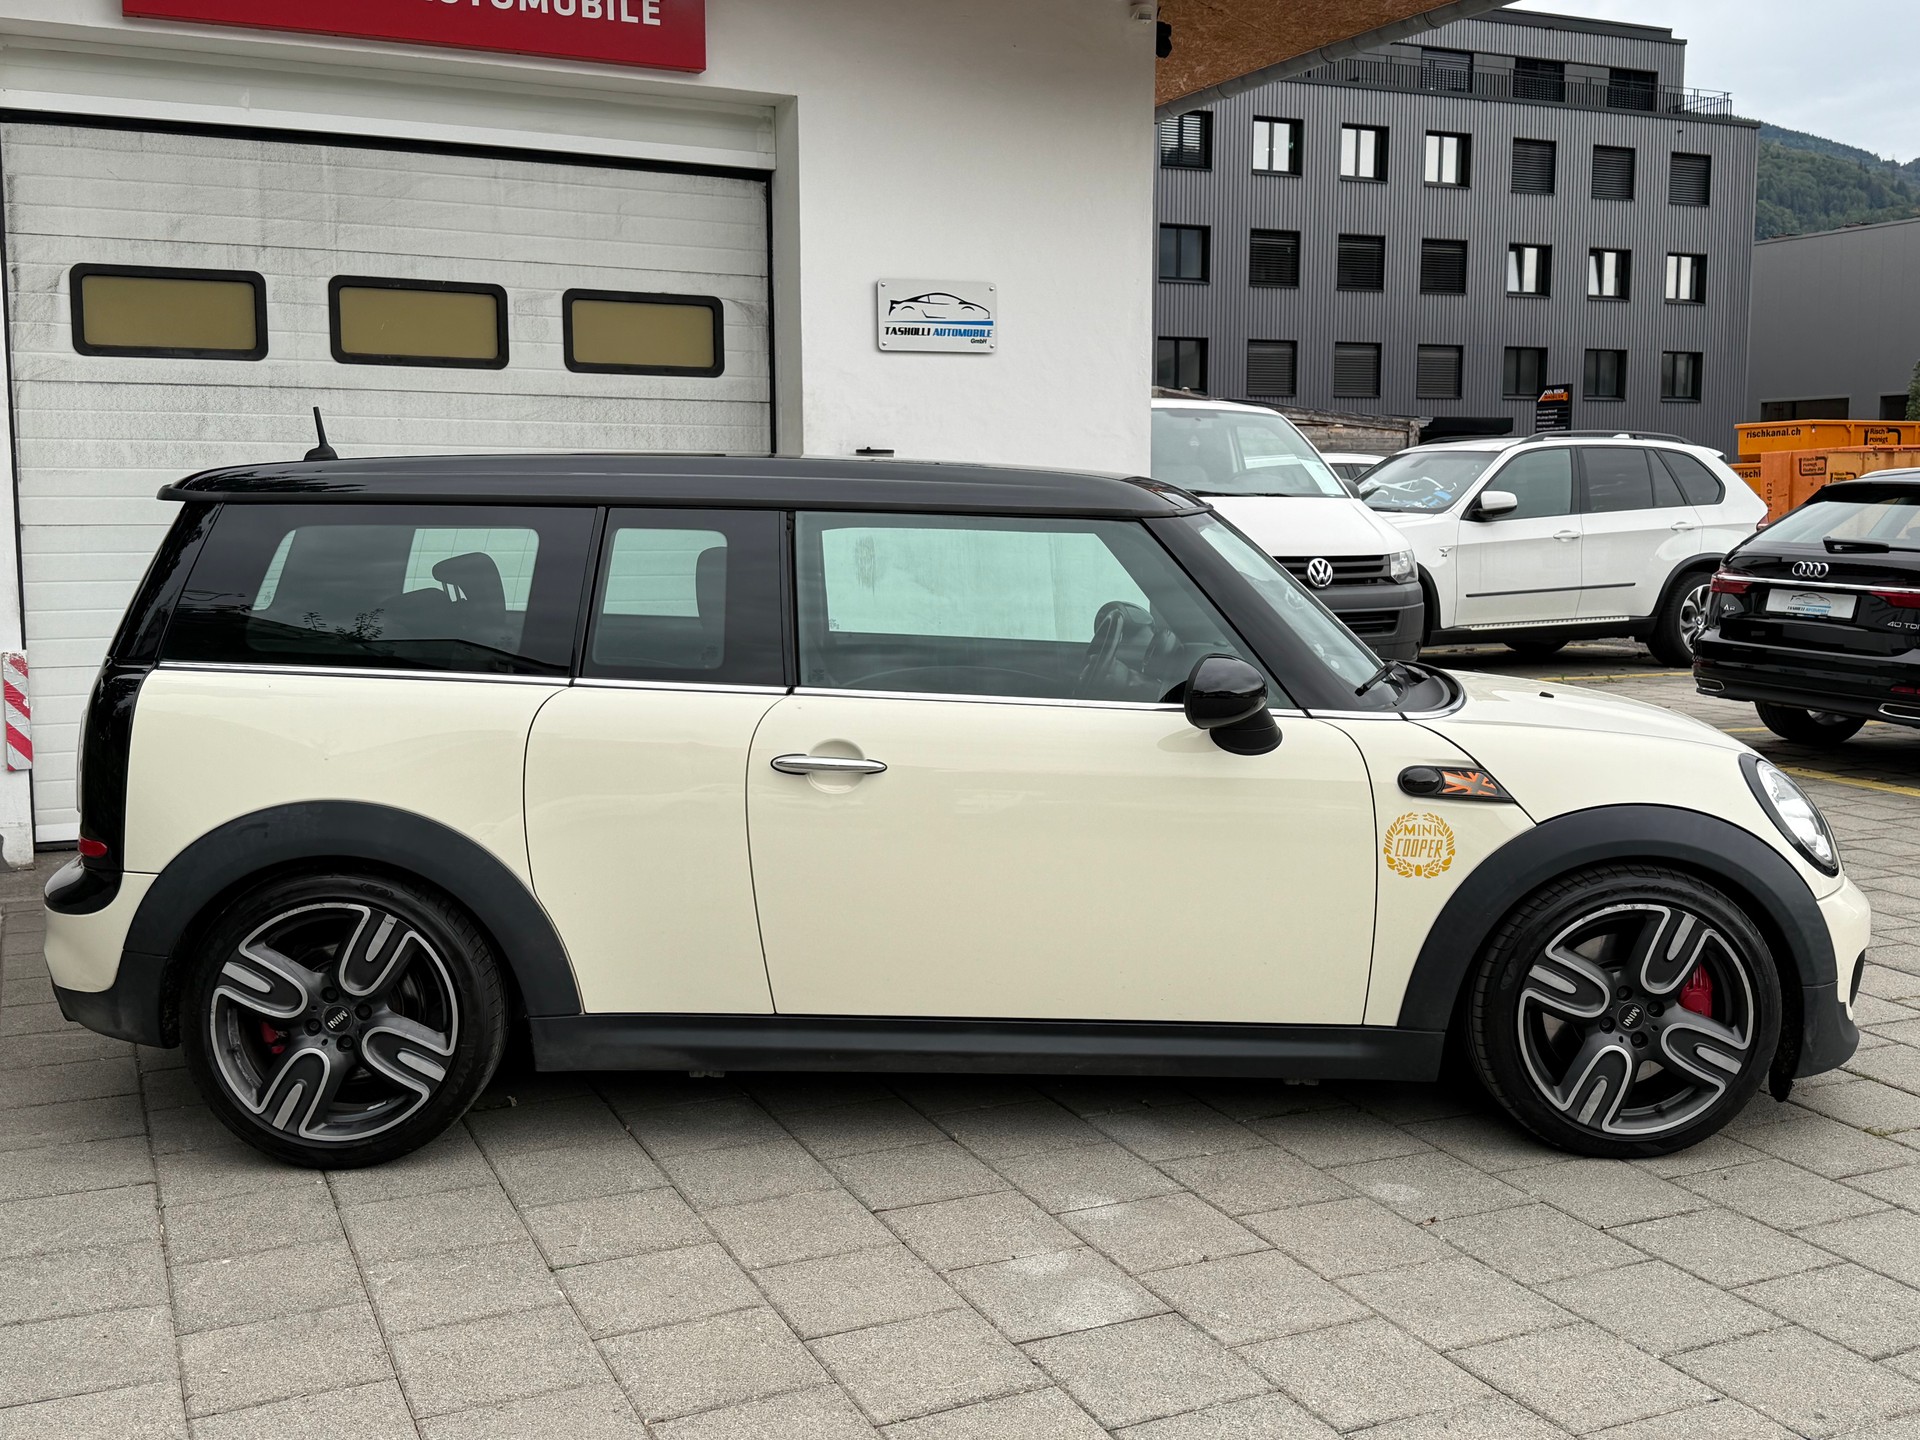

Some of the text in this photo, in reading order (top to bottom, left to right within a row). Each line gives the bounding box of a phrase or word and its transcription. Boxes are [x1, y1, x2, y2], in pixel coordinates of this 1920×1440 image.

[424, 0, 661, 26] OBILE
[885, 326, 993, 338] TASHOLLI AUTOMOBILE
[1746, 427, 1801, 439] rischkanal.ch
[1403, 823, 1437, 836] MINI
[1395, 838, 1444, 858] COOPER
[327, 1010, 348, 1029] MINI
[1622, 1006, 1640, 1027] MINI
